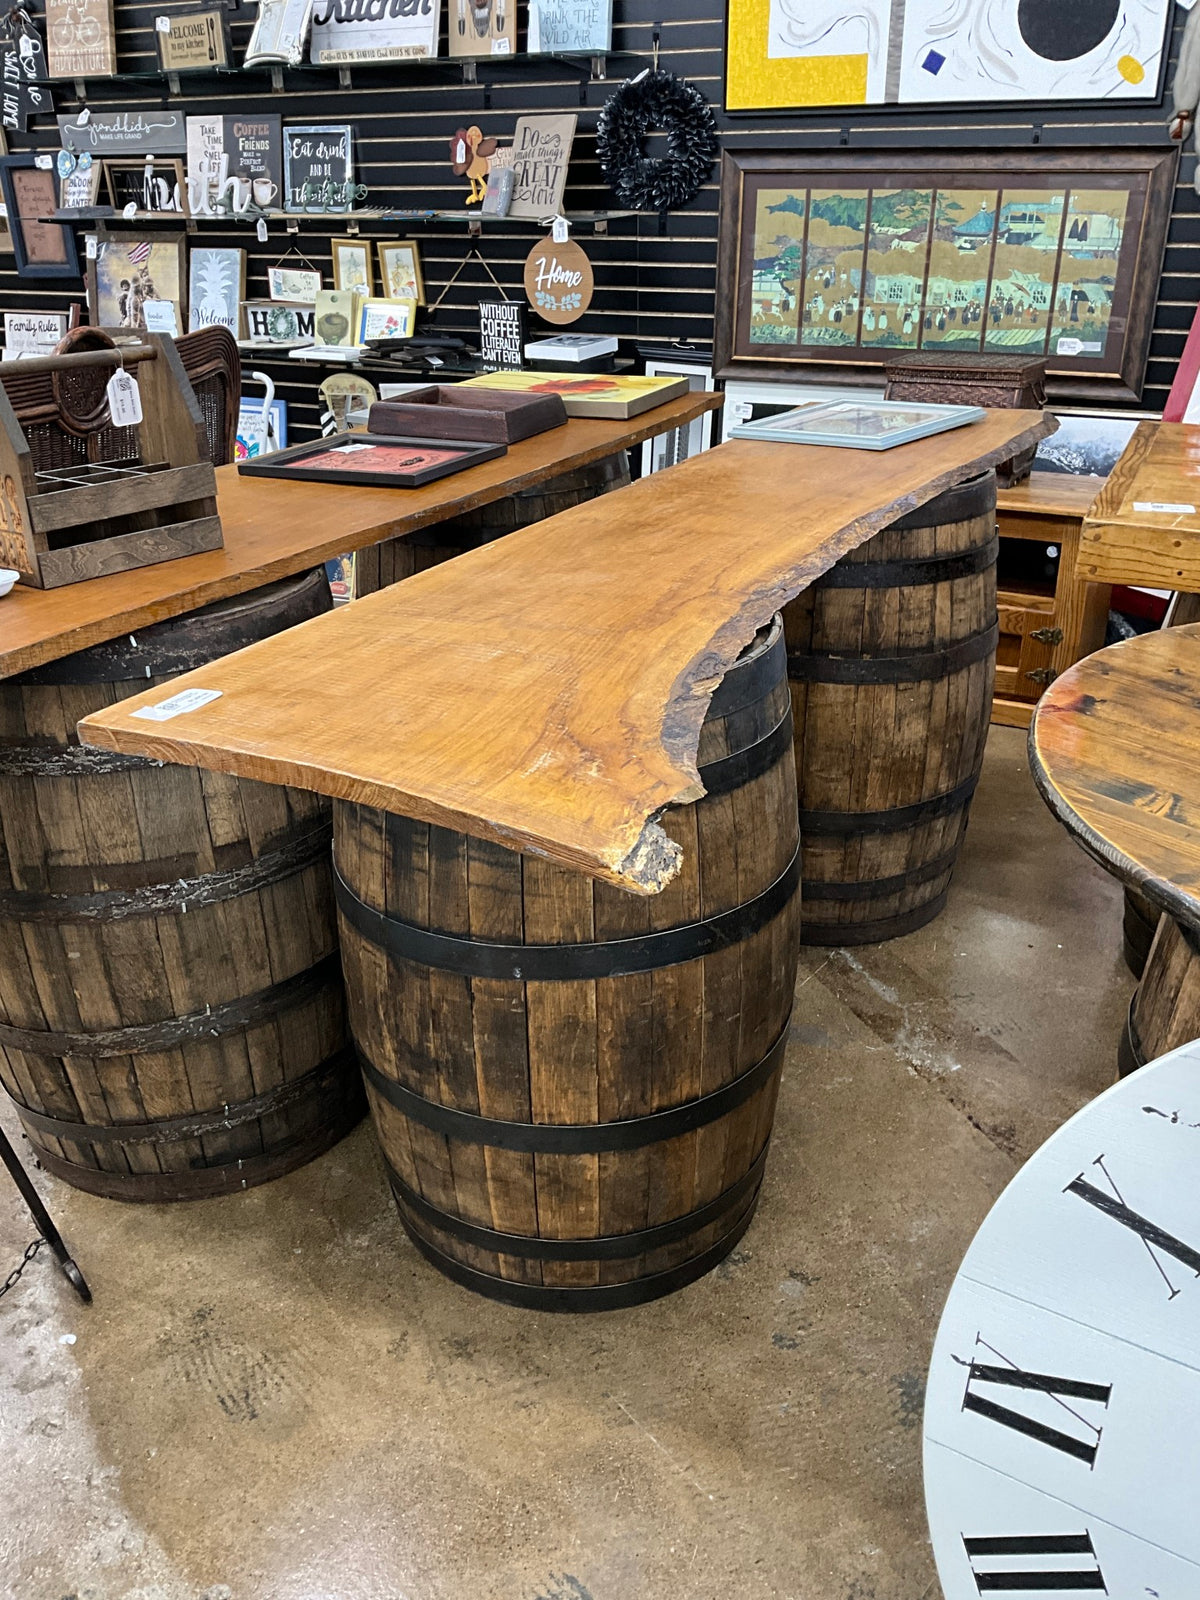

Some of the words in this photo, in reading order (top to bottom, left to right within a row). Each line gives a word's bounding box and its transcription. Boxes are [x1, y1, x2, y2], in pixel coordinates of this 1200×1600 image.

[573, 9, 599, 28] THE
[54, 48, 106, 72] ADVENTURE
[4, 51, 20, 90] SWEET
[2, 92, 19, 129] HOME
[64, 113, 176, 145] grandkids
[200, 125, 216, 136] TAKE
[233, 122, 269, 138] COFFEE
[206, 136, 223, 145] TIME
[239, 137, 270, 151] FRIENDS
[520, 126, 540, 151] DO
[203, 150, 222, 161] SMEL
[292, 138, 314, 159] Eat
[315, 136, 347, 160] drink
[537, 147, 565, 163] things
[309, 164, 323, 176] AND
[323, 163, 332, 176] BE
[513, 160, 562, 189] GREAT
[69, 178, 92, 188] BLOOM
[535, 257, 582, 290] Home
[192, 308, 236, 326] Welcome
[480, 303, 518, 320] WITHOUT
[9, 318, 37, 337] Family
[38, 320, 58, 332] Rules
[480, 318, 520, 339] COFFEE
[481, 335, 485, 348] I
[485, 336, 520, 351] LITERALLY
[502, 350, 521, 364] EVEN
